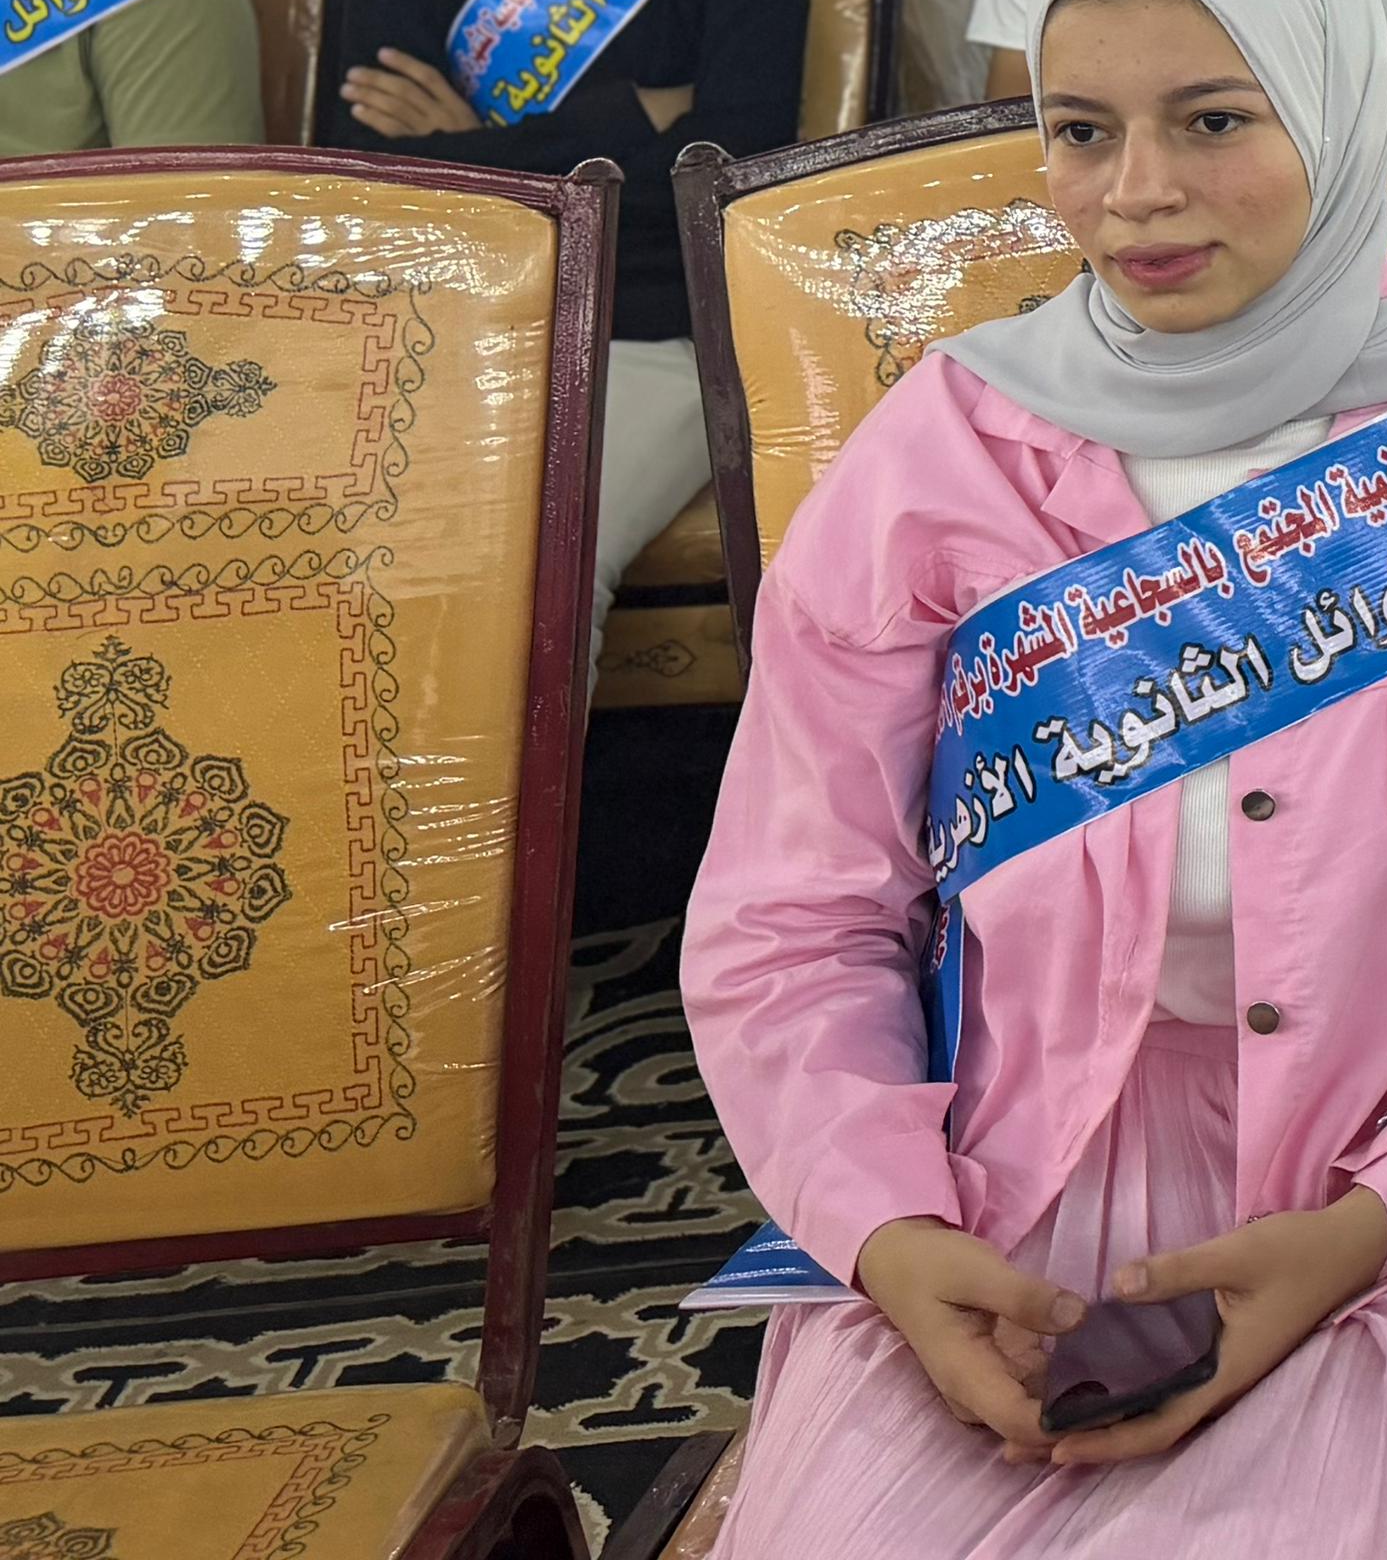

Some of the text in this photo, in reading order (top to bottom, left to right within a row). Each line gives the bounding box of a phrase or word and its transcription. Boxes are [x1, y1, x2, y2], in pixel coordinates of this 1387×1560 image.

[1233, 480, 1341, 587] المجتمع
[1064, 537, 1235, 649] بالسجاعية
[978, 601, 1079, 697] المشهرة
[1032, 632, 1273, 786] الثانوية
